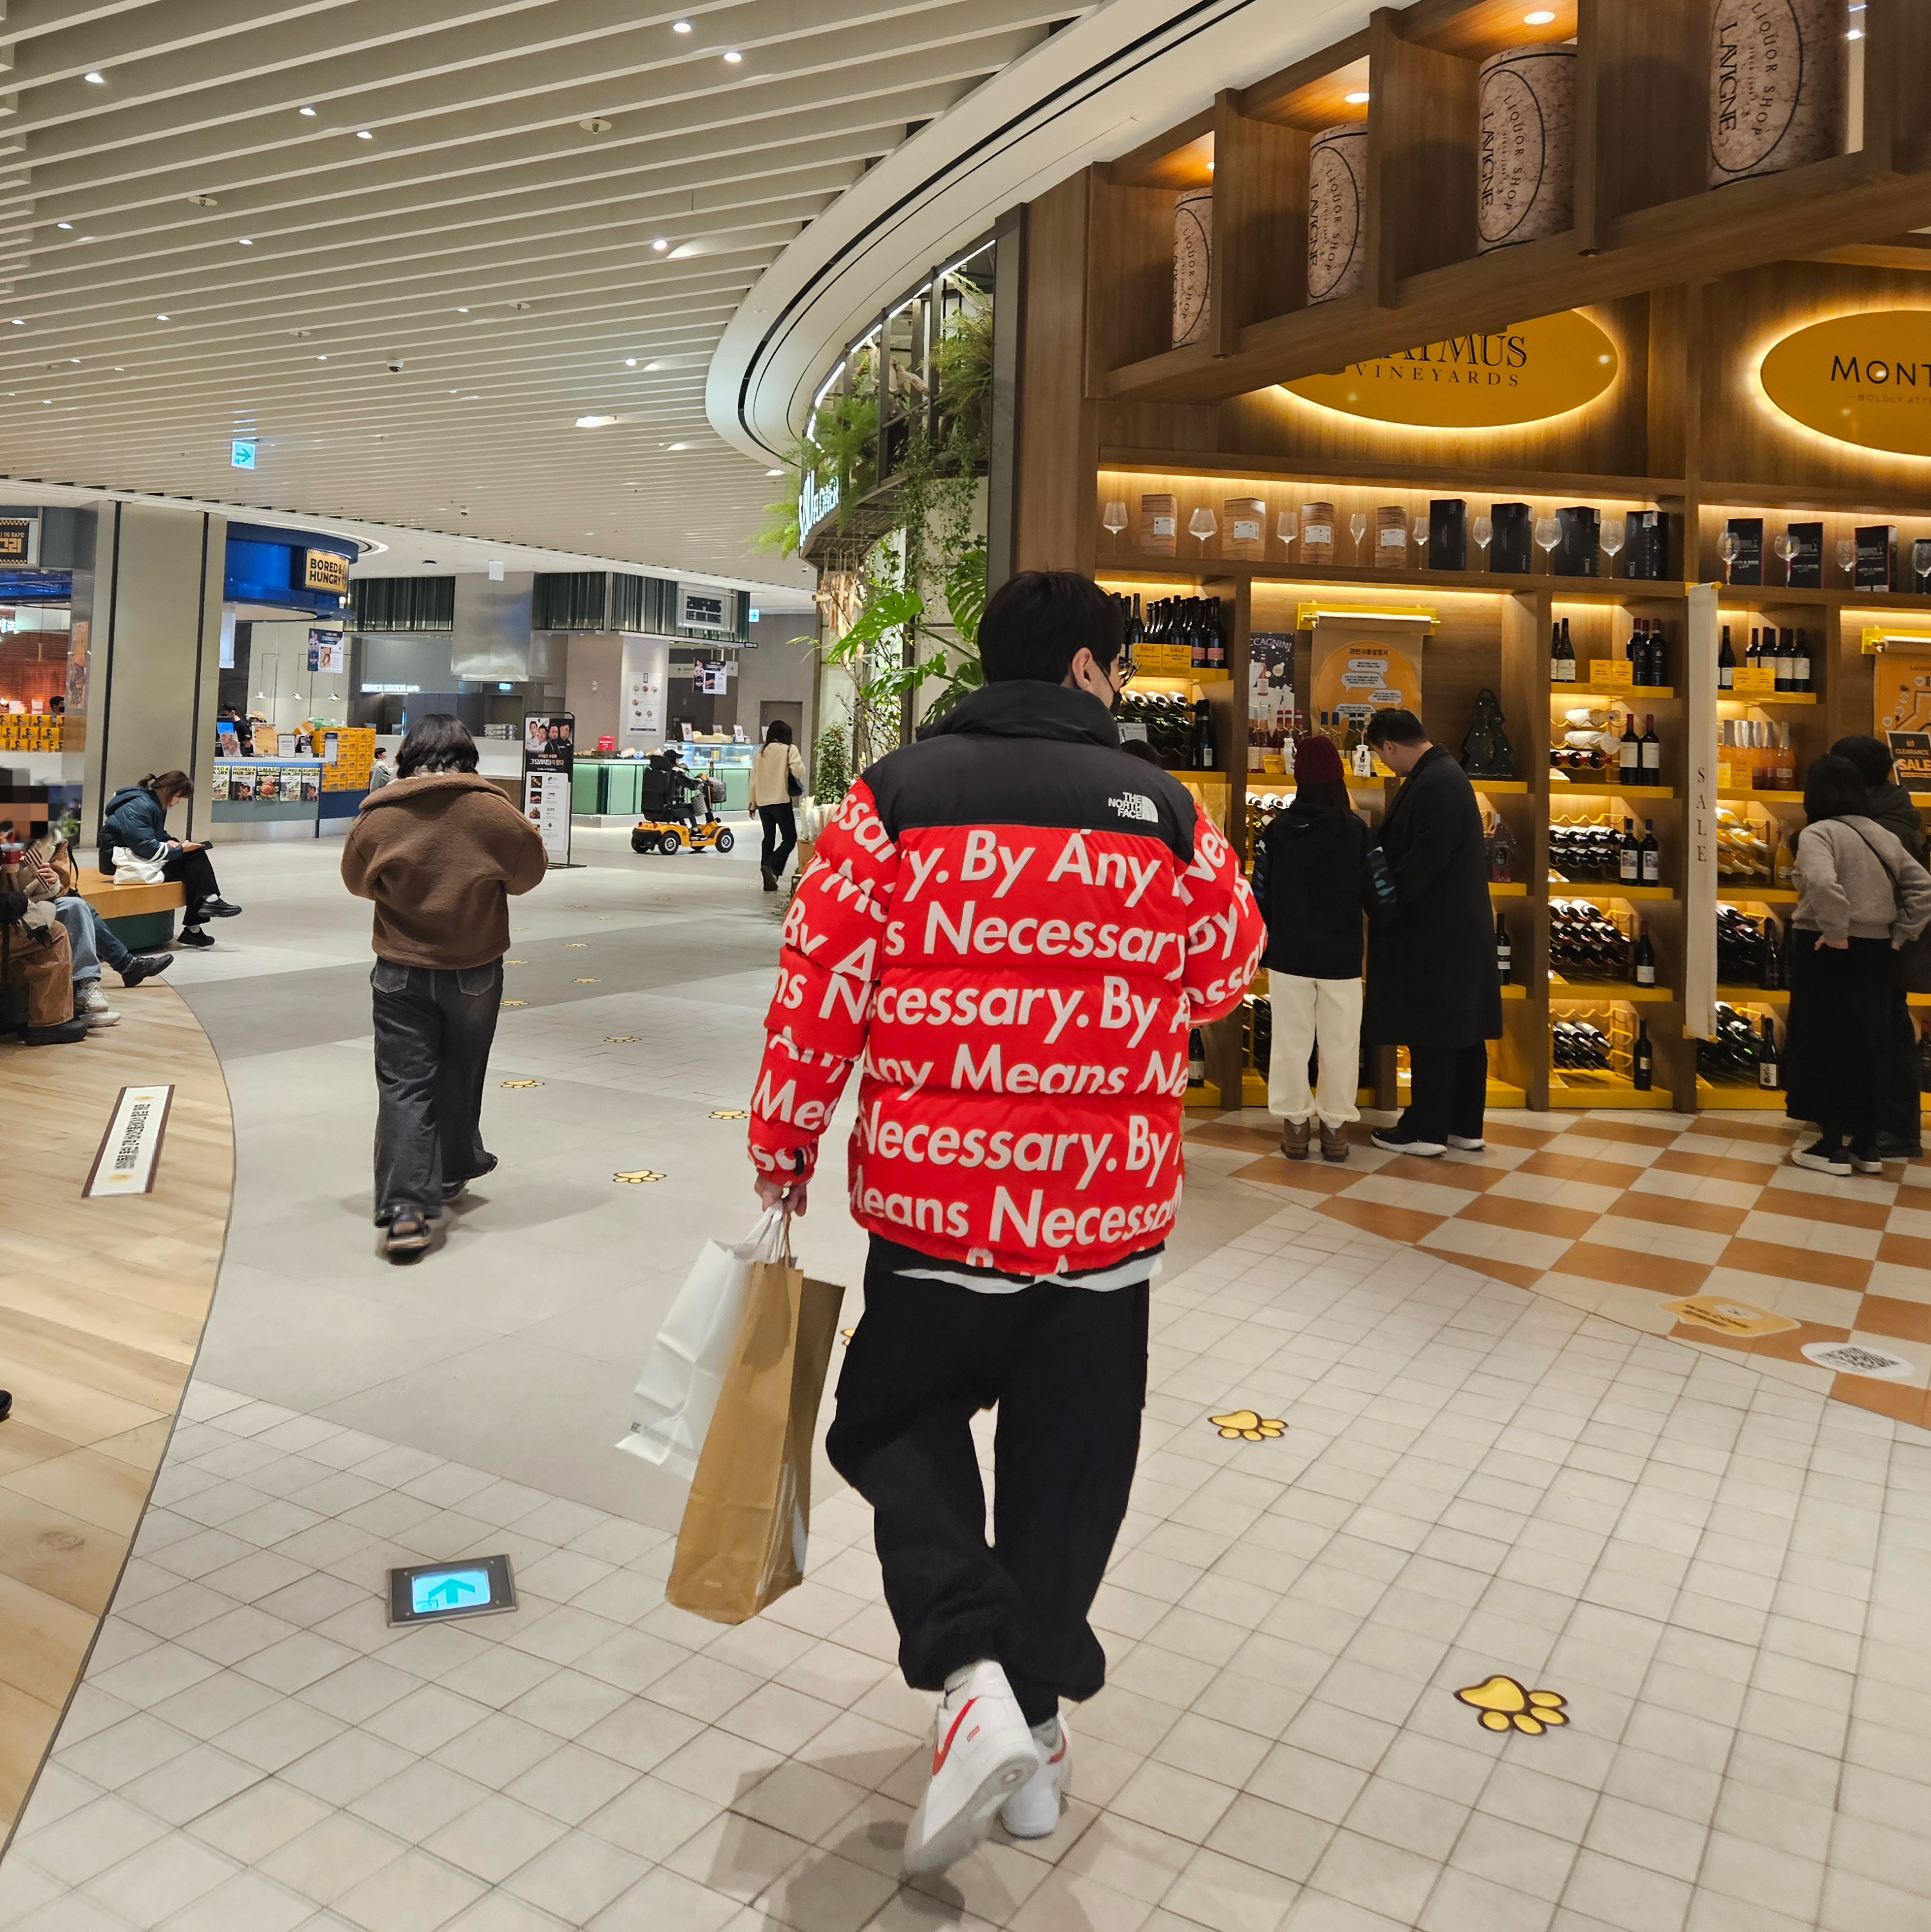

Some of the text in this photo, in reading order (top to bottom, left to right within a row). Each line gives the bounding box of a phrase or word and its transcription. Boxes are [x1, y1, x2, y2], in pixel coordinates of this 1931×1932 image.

[1751, 2, 1778, 73] LIQUOR
[1719, 21, 1738, 135] LAVIGNE
[1503, 95, 1524, 156] LIQUOR
[1326, 168, 1342, 223] LIQUOR
[1182, 227, 1196, 277] LIQUOR
[1355, 363, 1518, 386] VINEYARDS
[309, 571, 341, 586] HUNGRY
[1898, 759, 1931, 772] SALE
[1108, 797, 1142, 811] NORTH
[1117, 808, 1142, 820] FACE
[1122, 791, 1142, 803] THE
[1695, 766, 1707, 863] SALE
[961, 830, 1036, 898] By
[1046, 831, 1162, 907] Any
[1100, 975, 1161, 1049] By
[951, 1044, 1129, 1094] Means
[1126, 1115, 1173, 1188] By
